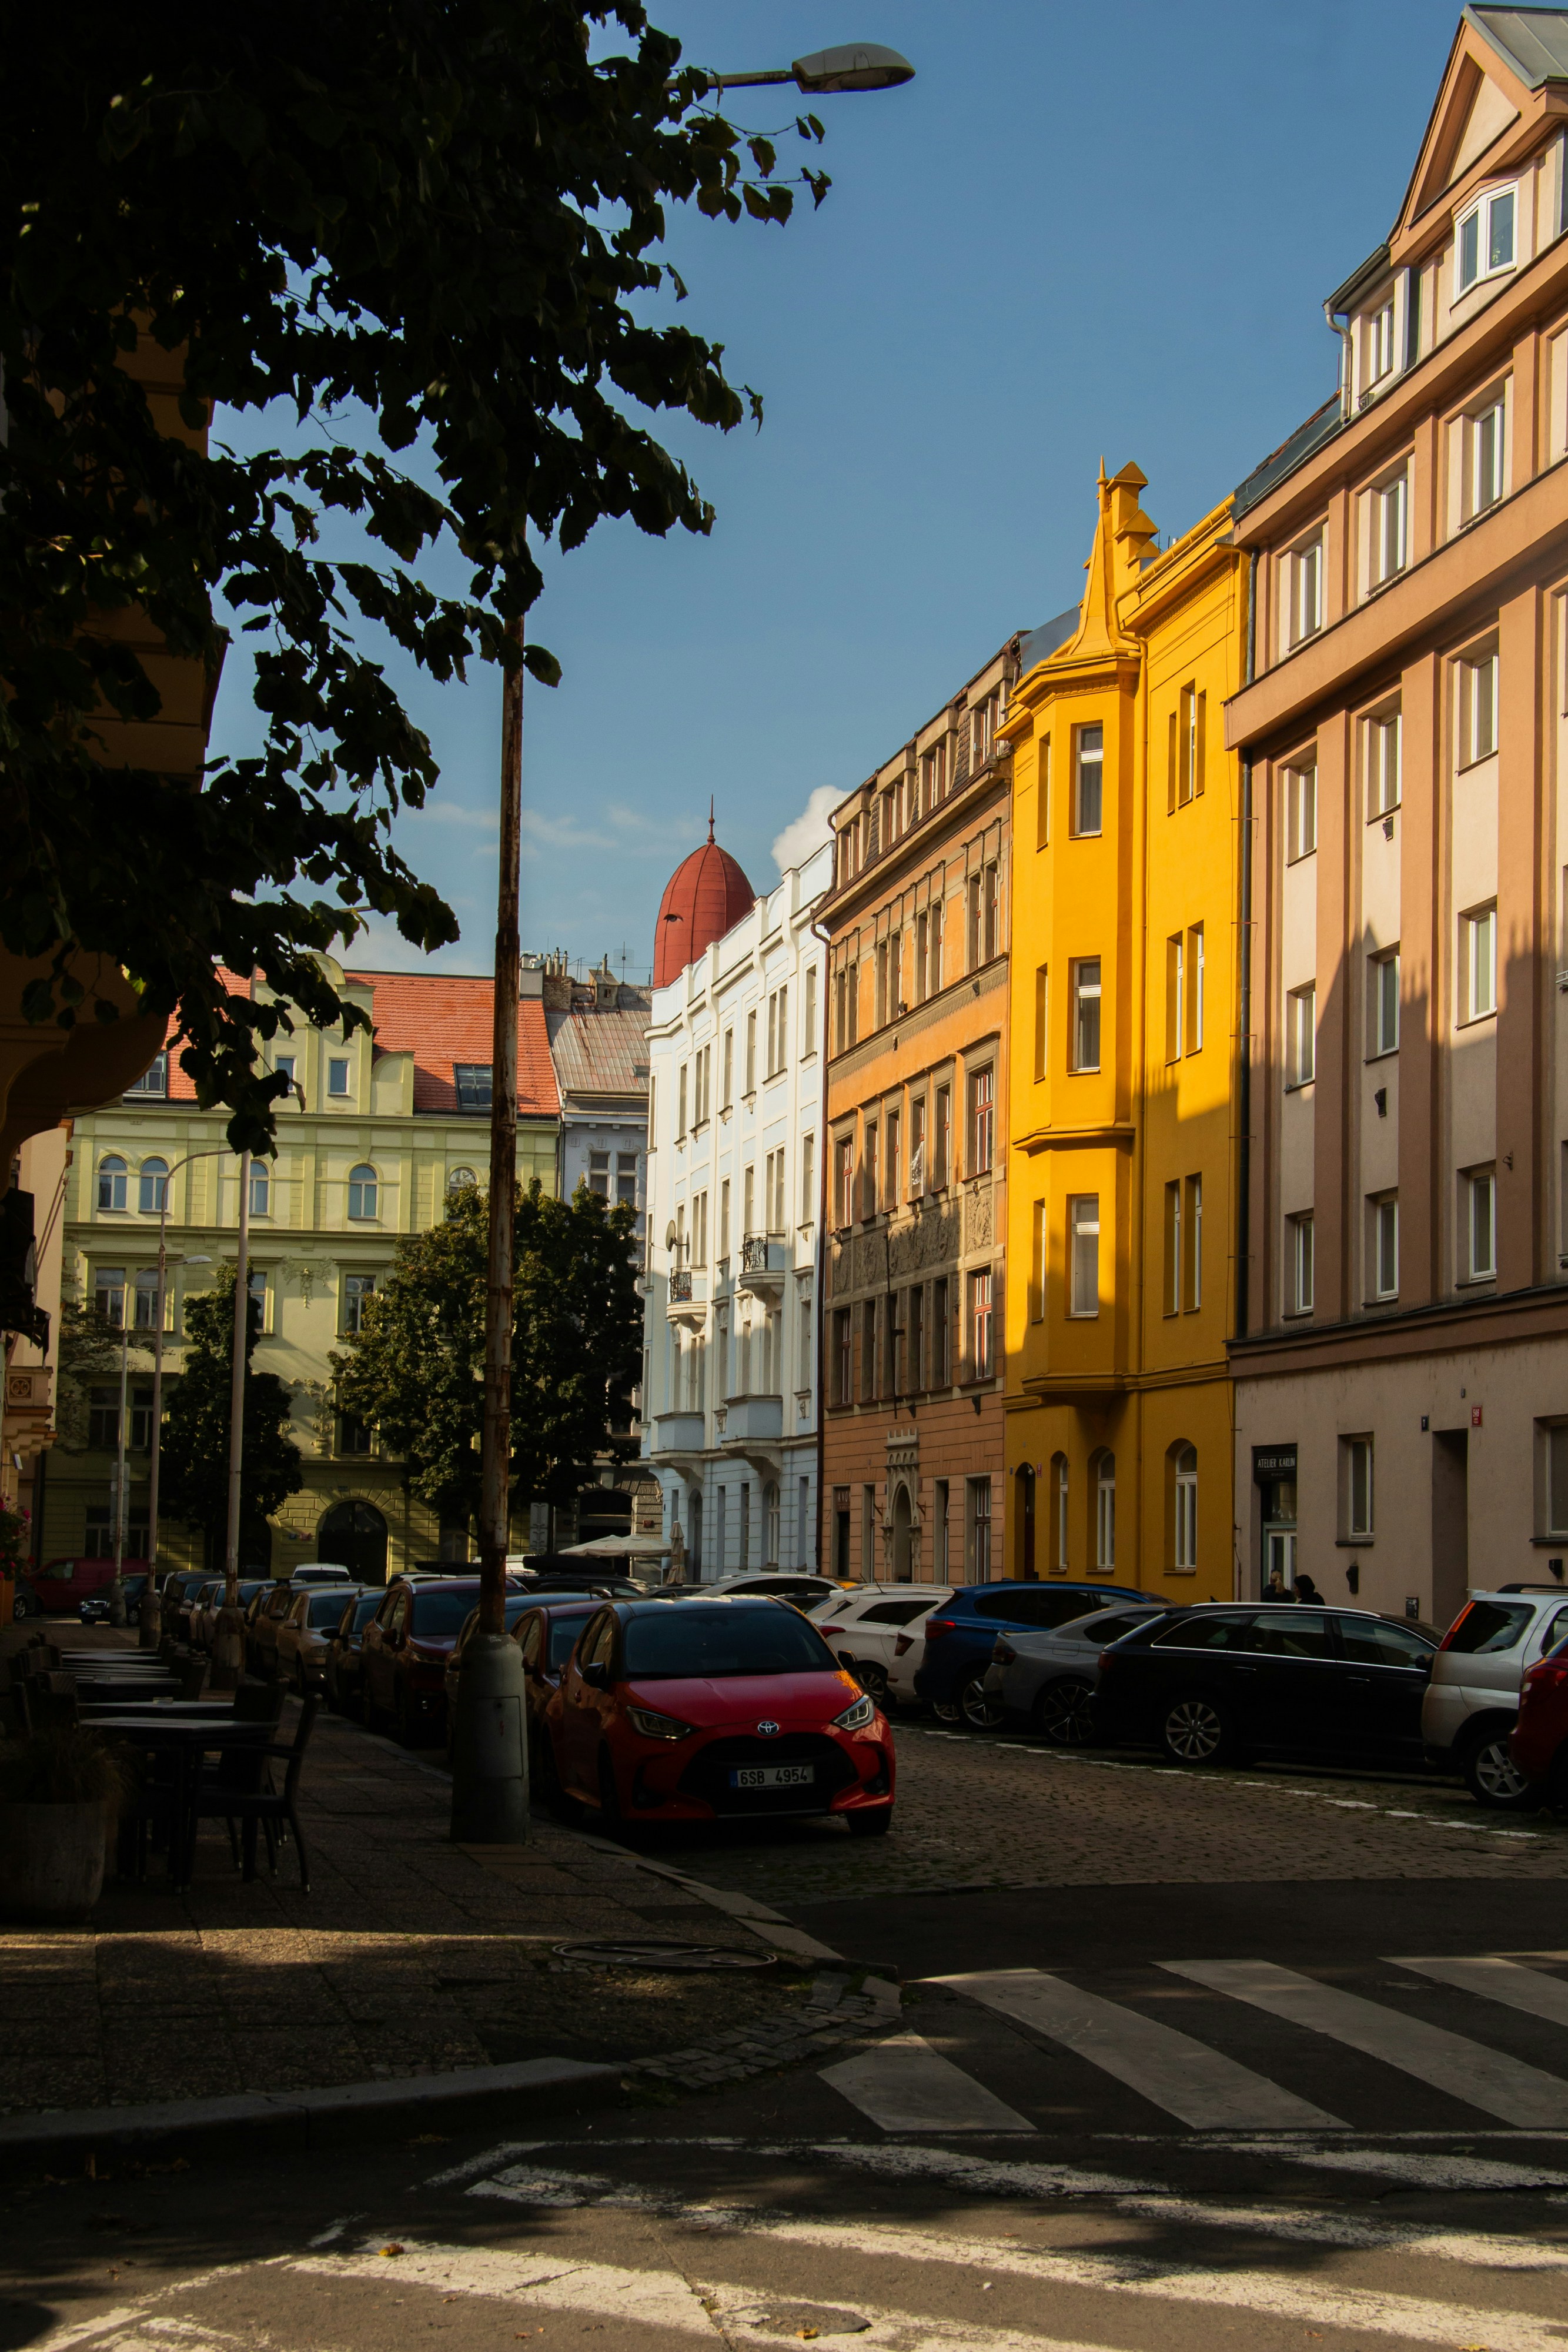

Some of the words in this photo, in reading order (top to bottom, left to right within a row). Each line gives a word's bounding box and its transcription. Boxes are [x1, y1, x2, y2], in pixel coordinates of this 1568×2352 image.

[1258, 1458, 1277, 1468] ATELIER
[740, 1770, 765, 1785] 6SB
[775, 1768, 807, 1783] 4954
